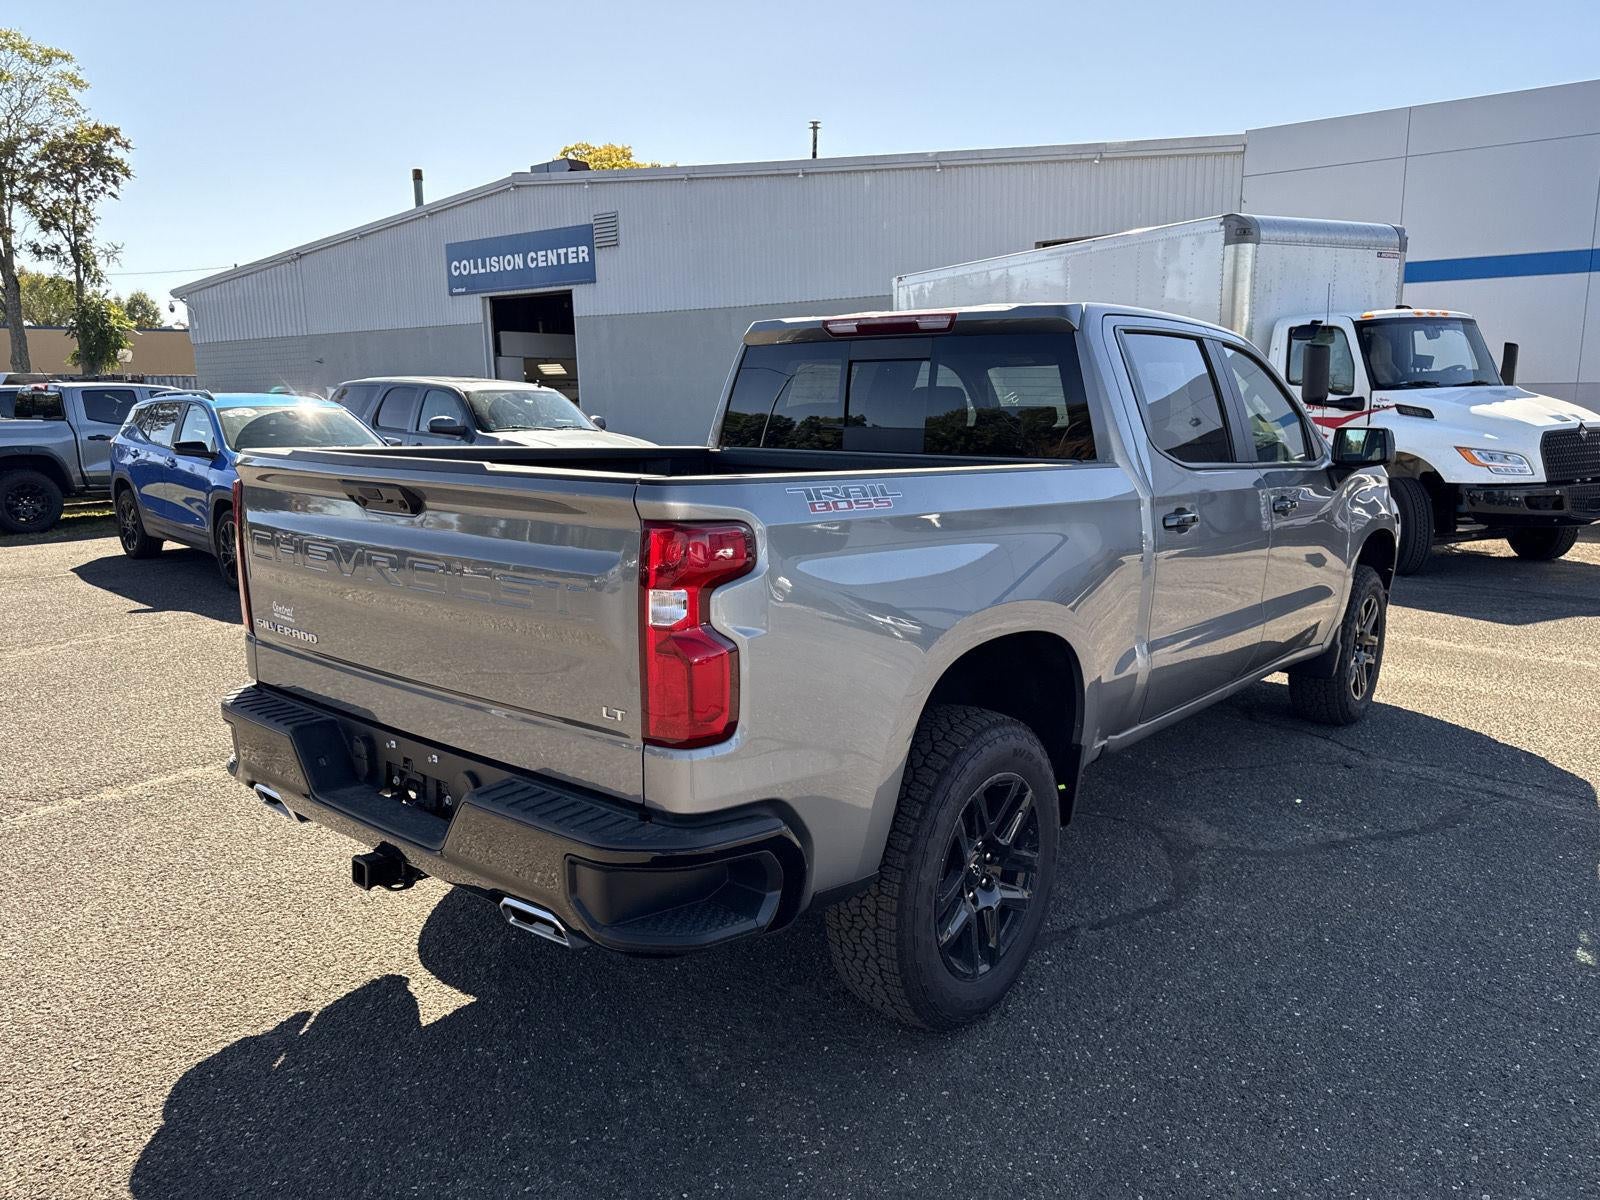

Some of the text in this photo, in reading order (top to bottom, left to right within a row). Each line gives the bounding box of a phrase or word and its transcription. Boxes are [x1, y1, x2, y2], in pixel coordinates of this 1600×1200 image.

[451, 245, 590, 277] COLLISION CENTER
[785, 483, 903, 502] TRAIL
[808, 497, 894, 515] BOSS
[272, 600, 294, 617] Central
[256, 618, 319, 644] SILVERADO
[602, 705, 626, 721] LT
